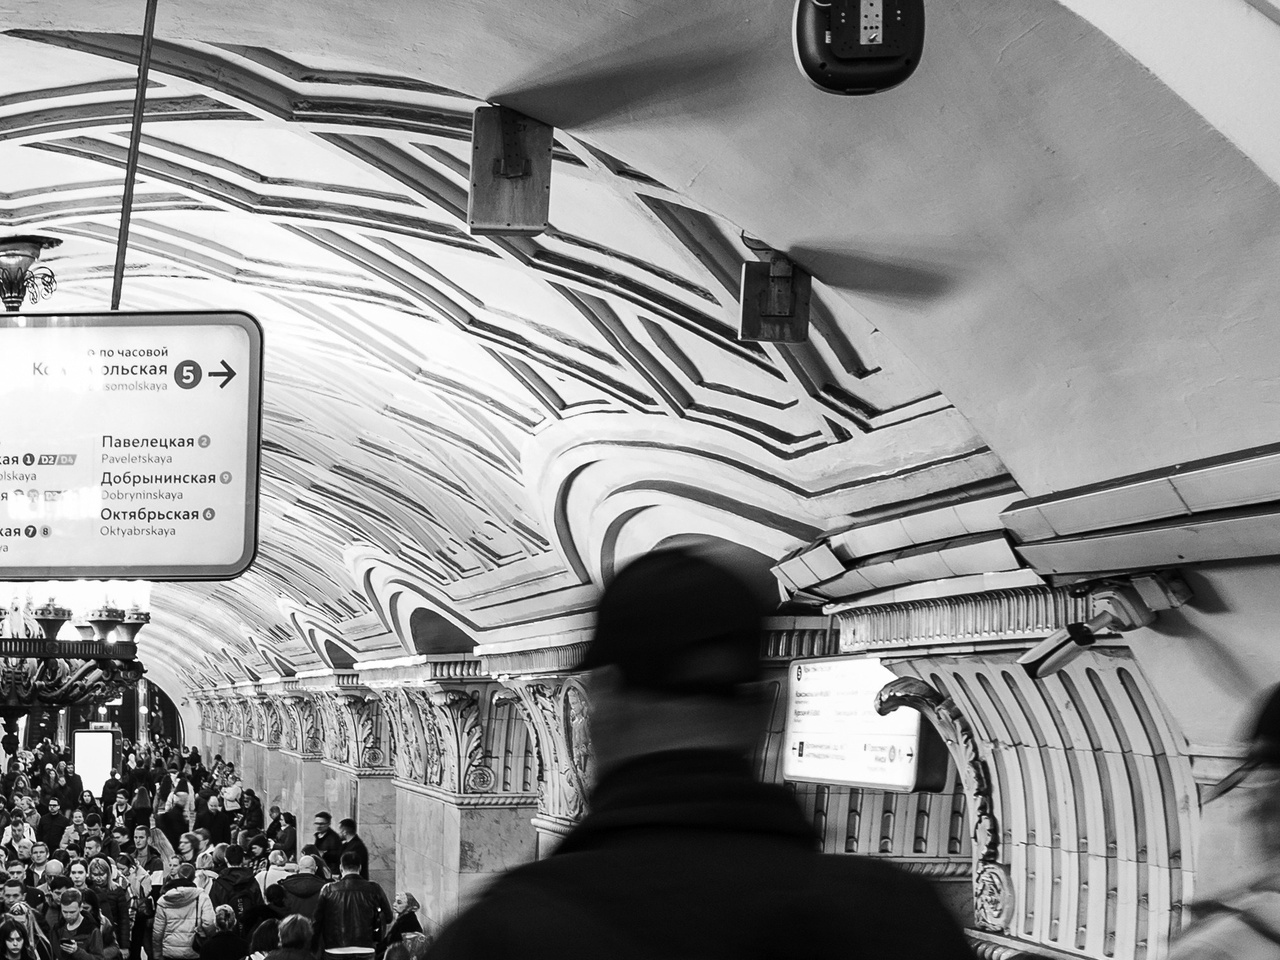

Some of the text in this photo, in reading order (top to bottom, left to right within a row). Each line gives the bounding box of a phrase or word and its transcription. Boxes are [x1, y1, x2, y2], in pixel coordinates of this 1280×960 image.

[118, 347, 168, 357] часовой
[33, 362, 168, 375] Кольская
[90, 380, 168, 392] somolskaya
[103, 436, 194, 449] Павелецкая
[102, 453, 172, 465] Paveletskaya
[101, 471, 216, 486] Добрынинская
[101, 507, 199, 522] Октябрьская
[100, 526, 176, 537] Oktyabrskaya
